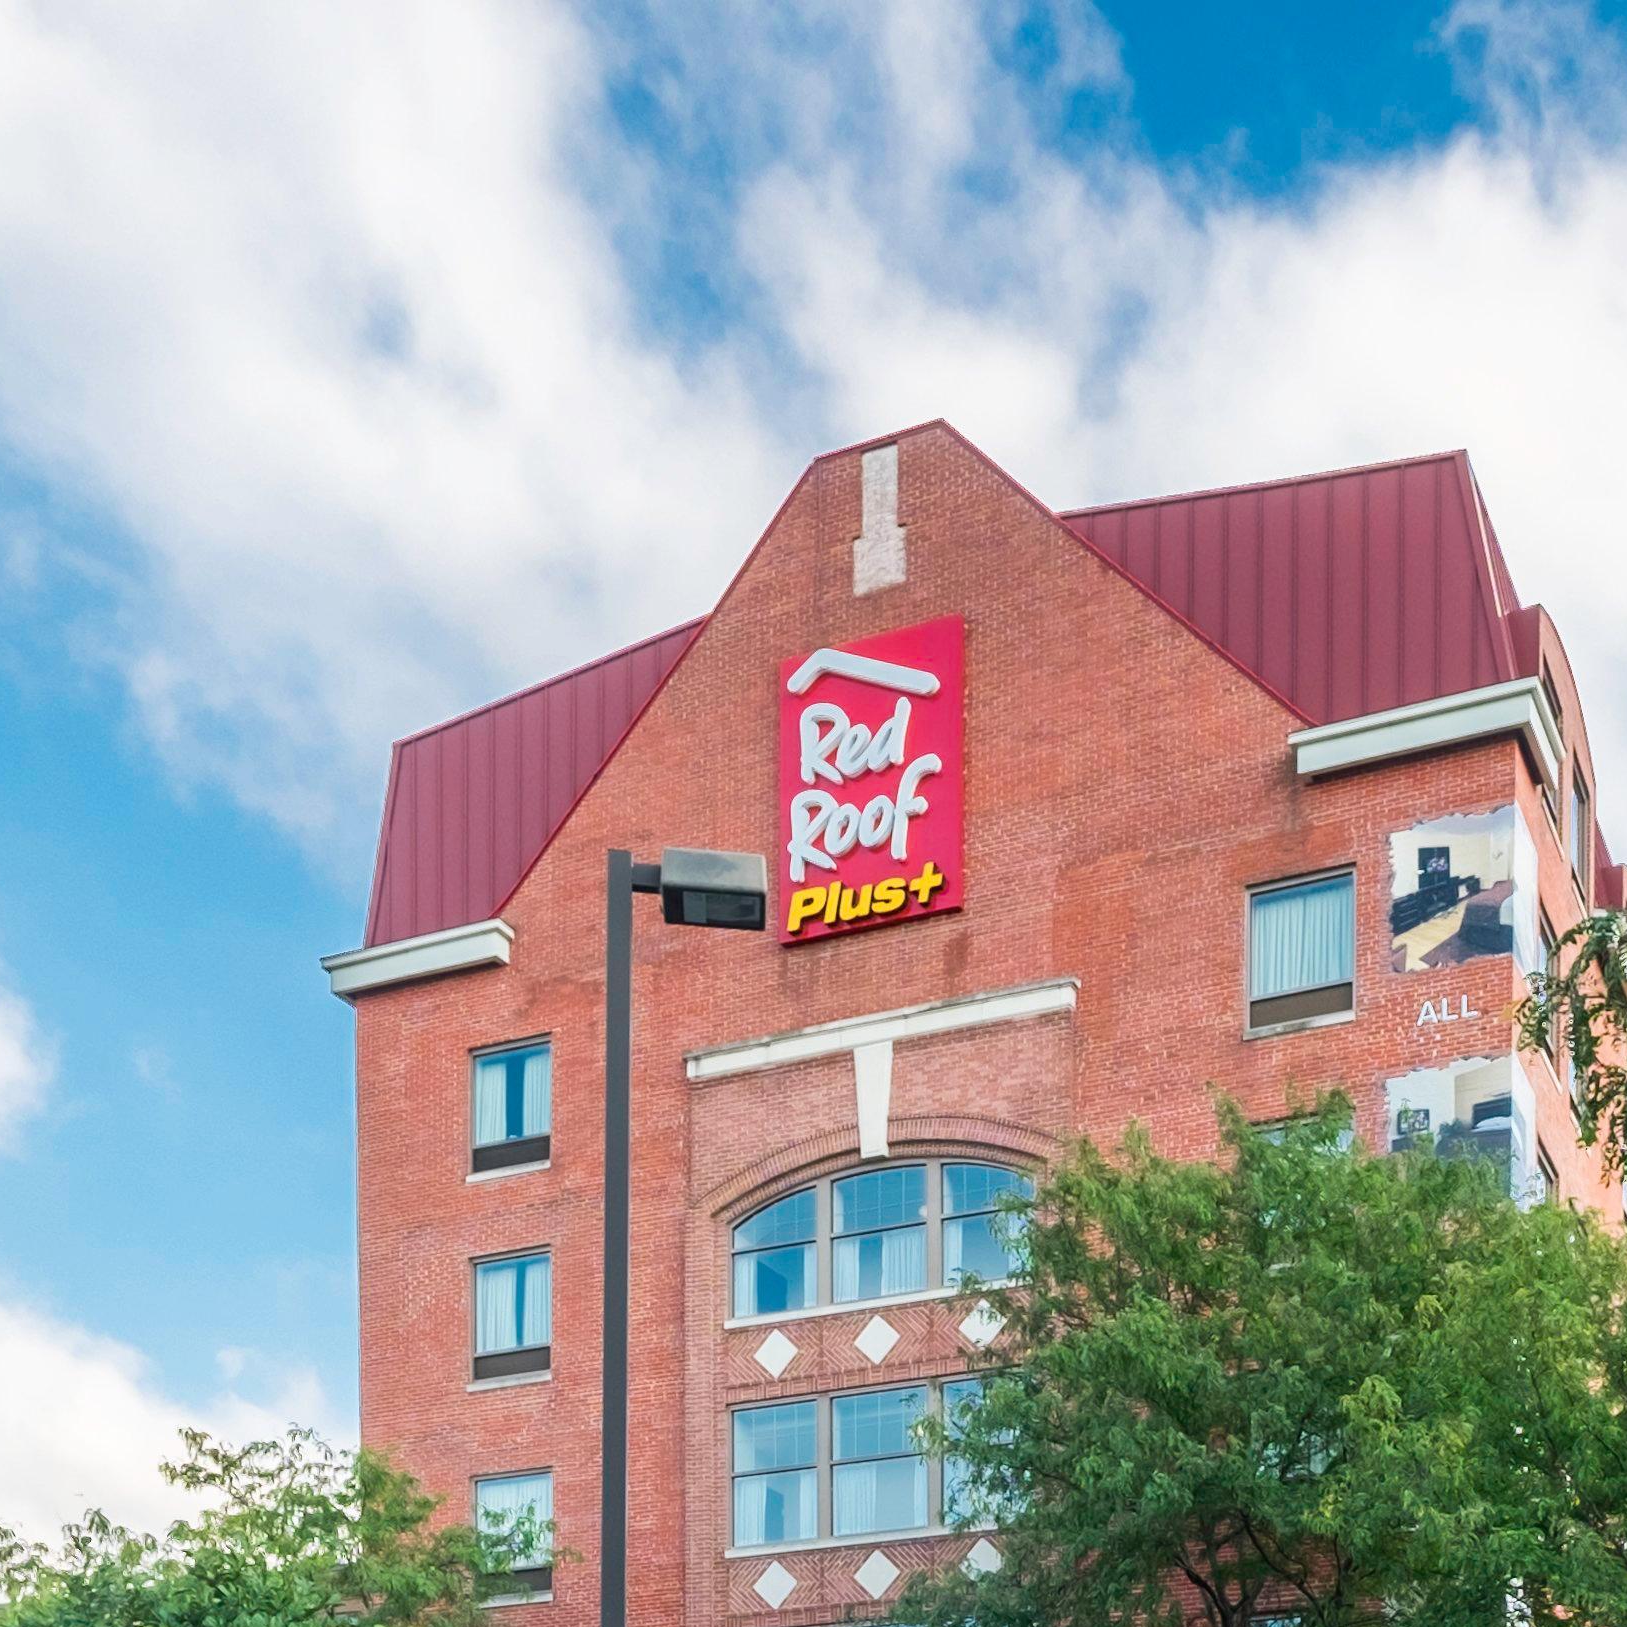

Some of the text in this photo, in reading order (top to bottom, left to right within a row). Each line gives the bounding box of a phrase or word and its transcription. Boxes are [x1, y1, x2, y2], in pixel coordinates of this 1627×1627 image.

[799, 696, 912, 785] Red
[786, 753, 943, 883] Roof
[786, 861, 945, 933] Plus+
[1416, 993, 1478, 1027] ALL
